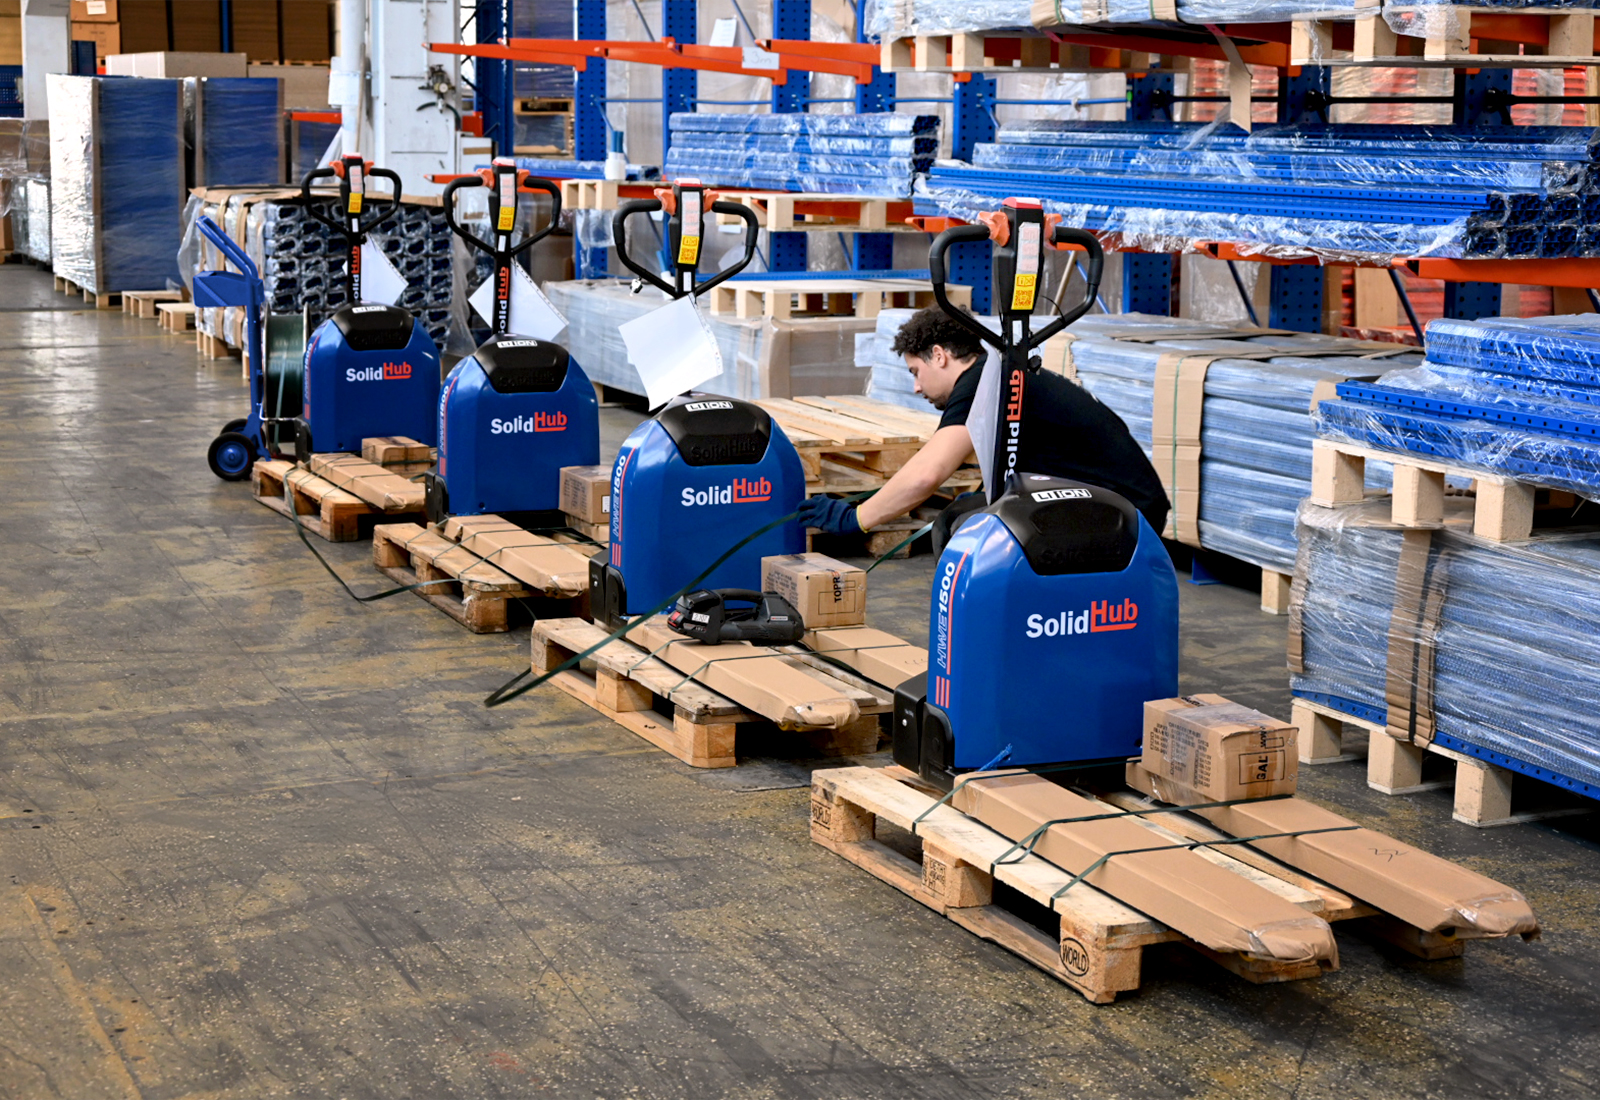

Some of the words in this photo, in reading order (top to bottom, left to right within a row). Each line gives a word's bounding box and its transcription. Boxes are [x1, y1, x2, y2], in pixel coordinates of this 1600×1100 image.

[351, 245, 361, 299] olidHub
[498, 266, 509, 334] olidHub
[346, 361, 412, 382] SolidHub
[490, 411, 568, 434] SolidHub
[612, 455, 626, 537] HWE1500
[681, 476, 772, 506] SolidHub
[936, 562, 956, 669] HWE1500
[1026, 598, 1138, 638] SolidHub
[1062, 944, 1087, 972] WORLD
